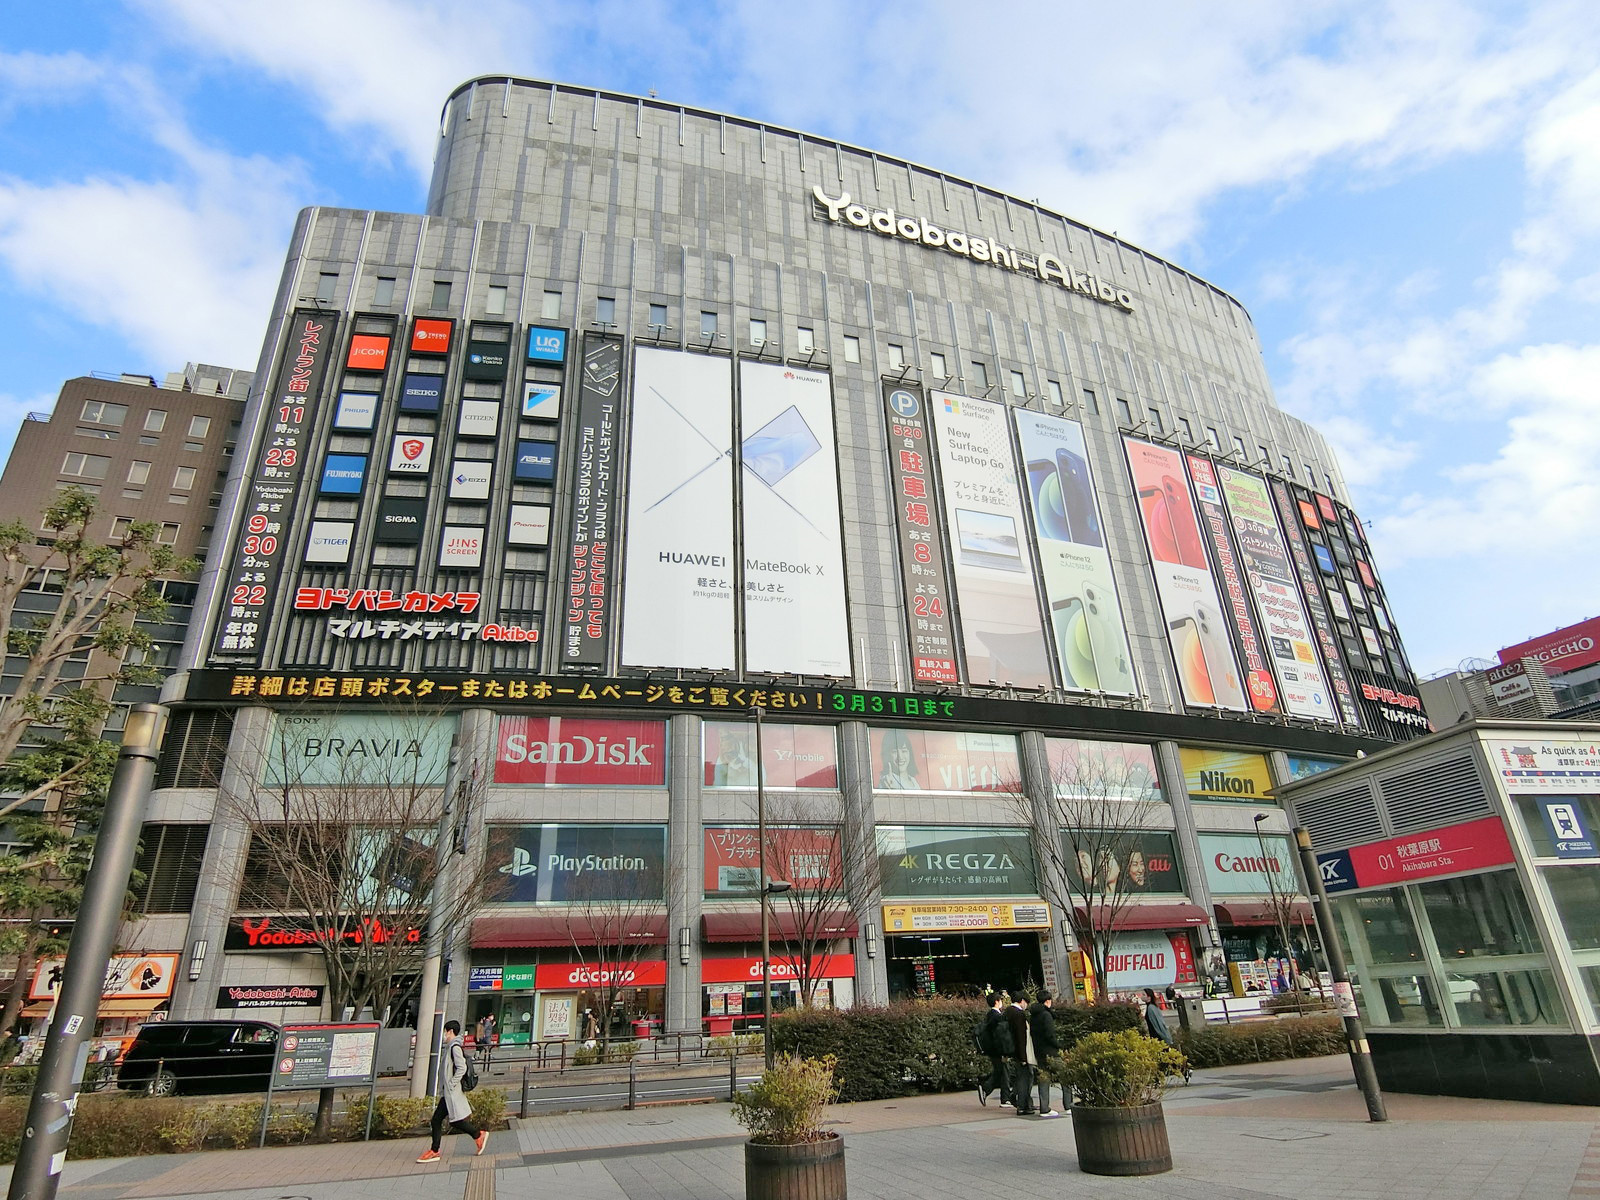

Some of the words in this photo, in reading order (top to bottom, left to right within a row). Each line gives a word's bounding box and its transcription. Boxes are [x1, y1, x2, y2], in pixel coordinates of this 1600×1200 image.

[536, 336, 560, 347] UQ
[288, 320, 323, 393] レストラン街
[796, 375, 823, 384] HUAWEI
[406, 388, 438, 397] SEIKO
[283, 395, 308, 406] あさ
[280, 406, 305, 424] 11
[962, 402, 995, 415] Microsoft
[963, 410, 990, 421] Surface
[275, 423, 300, 434] 時から
[893, 425, 922, 439] 520
[947, 427, 971, 439] New
[1040, 424, 1058, 432] iPhone
[273, 437, 297, 447] よる
[903, 438, 914, 449] 台
[948, 440, 989, 454] Surface
[265, 449, 297, 467] 23
[520, 455, 552, 465] ASUS
[950, 452, 987, 467] Laptop
[990, 459, 1004, 469] Go
[264, 466, 291, 478] 時まで
[255, 486, 293, 494] Yodobashi
[900, 450, 930, 527] 駐車場
[256, 502, 282, 513] あさ
[248, 515, 281, 534] 9時
[385, 515, 417, 523] SIGMA
[908, 530, 931, 541] あさ
[243, 535, 277, 555] 30
[914, 543, 931, 563] 8
[1065, 553, 1084, 562] iPhone
[242, 556, 270, 568] 分から
[659, 551, 726, 567] HUAWEI
[746, 559, 811, 575] MateBook
[816, 565, 825, 576] X
[240, 572, 266, 582] よる
[911, 564, 936, 577] 時から
[746, 582, 785, 593] 美しさと
[915, 583, 938, 595] よる
[231, 585, 266, 605] 22
[294, 587, 481, 613] ヨドバシカメラ
[231, 606, 259, 618] 時まで
[914, 595, 944, 618] 24
[225, 622, 258, 635] 年中
[329, 619, 482, 641] マルチメディア
[482, 623, 538, 642] Akiba
[917, 619, 943, 631] 時まで
[221, 635, 255, 649] 無休
[916, 635, 948, 646] 高さ制限
[1550, 637, 1594, 658] ECHO
[1248, 671, 1273, 697] 5%
[1497, 687, 1531, 701] Restaurant
[832, 694, 955, 717] 3月31日まで
[284, 717, 321, 725] SONY
[304, 738, 423, 758] BRAVIA
[505, 734, 652, 767] SanDisk
[1541, 746, 1552, 755] As
[1554, 746, 1576, 756] quick
[1589, 745, 1596, 755] 4
[1200, 770, 1255, 794] Nikon
[1378, 854, 1395, 871] 01
[1396, 838, 1442, 857] 秋葉原駅
[548, 854, 645, 876] PlayStation
[899, 854, 920, 869] 4K
[925, 853, 1015, 870] REGZA
[1148, 858, 1171, 872] au
[1214, 852, 1281, 873] Canon
[1402, 859, 1437, 873] Akihabara
[1438, 856, 1454, 866] Sta.
[960, 918, 989, 927] 2,000円
[1105, 952, 1165, 972] BUFFALO
[505, 973, 533, 981] りそな銀行
[568, 967, 635, 983] docomo
[229, 987, 317, 999] Yodobashi-Akiba
[549, 1002, 568, 1012] 法人
